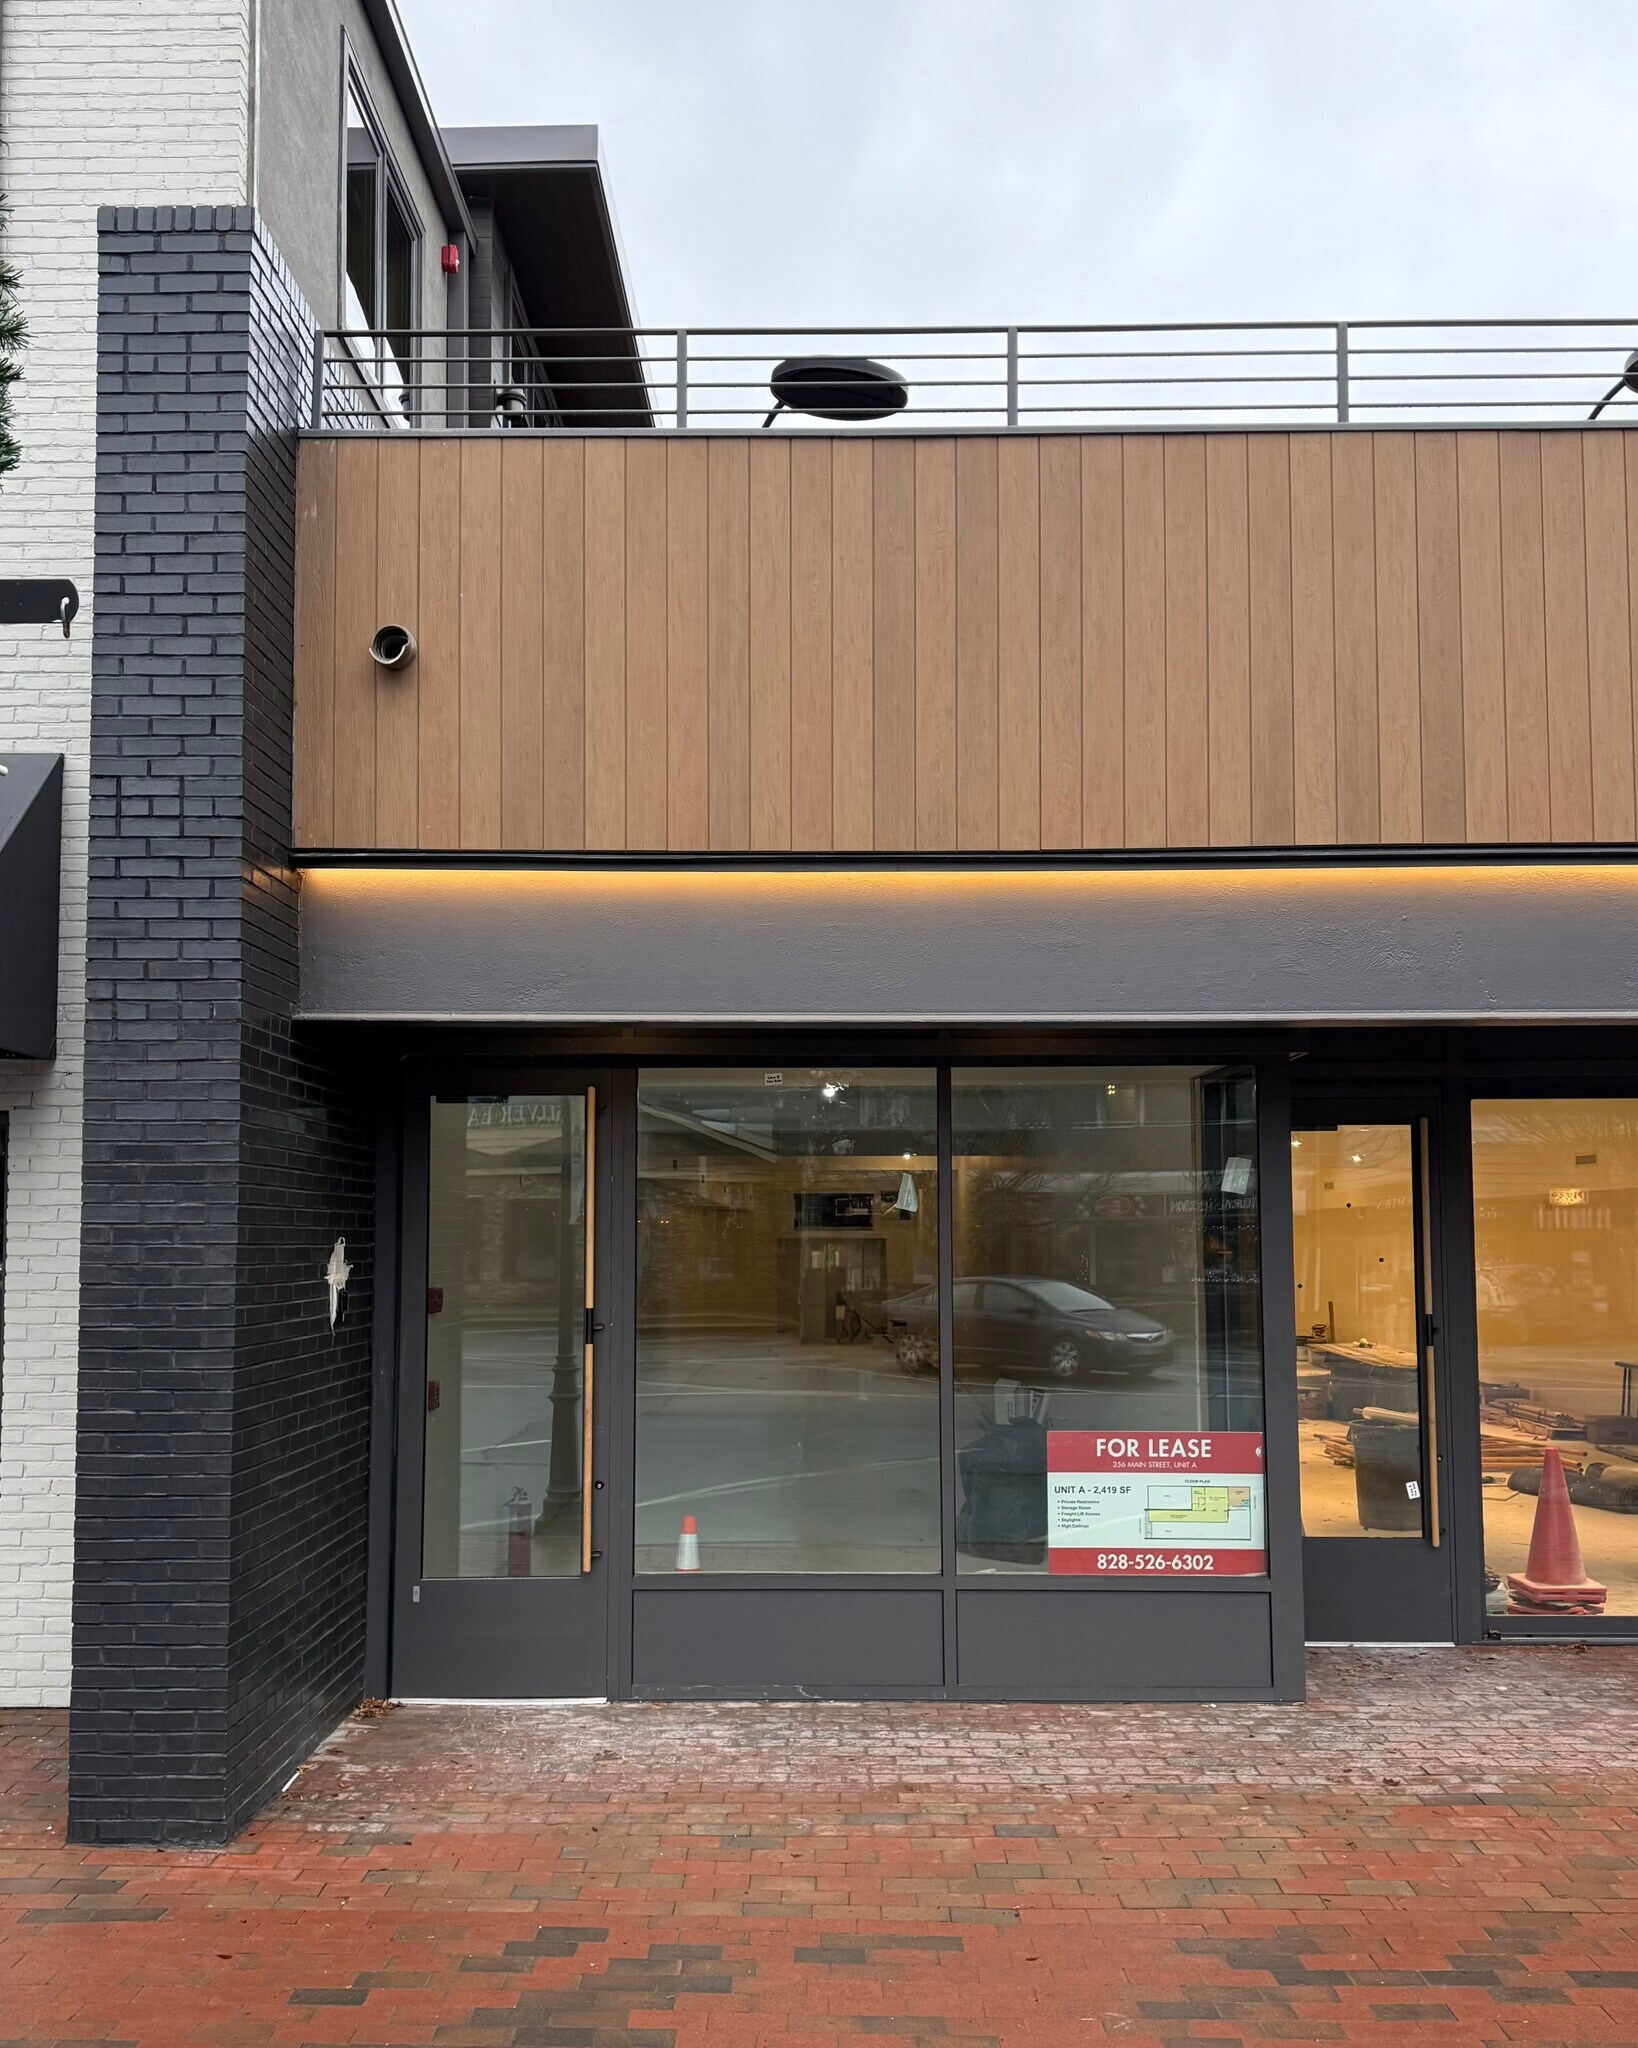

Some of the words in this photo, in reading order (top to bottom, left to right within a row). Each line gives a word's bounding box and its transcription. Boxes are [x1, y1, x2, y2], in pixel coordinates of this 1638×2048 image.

[1096, 1438, 1140, 1458] FOR
[1148, 1438, 1212, 1458] LEASE
[1093, 1486, 1117, 1494] 2,419
[1097, 1554, 1214, 1570] 828-526-6302
